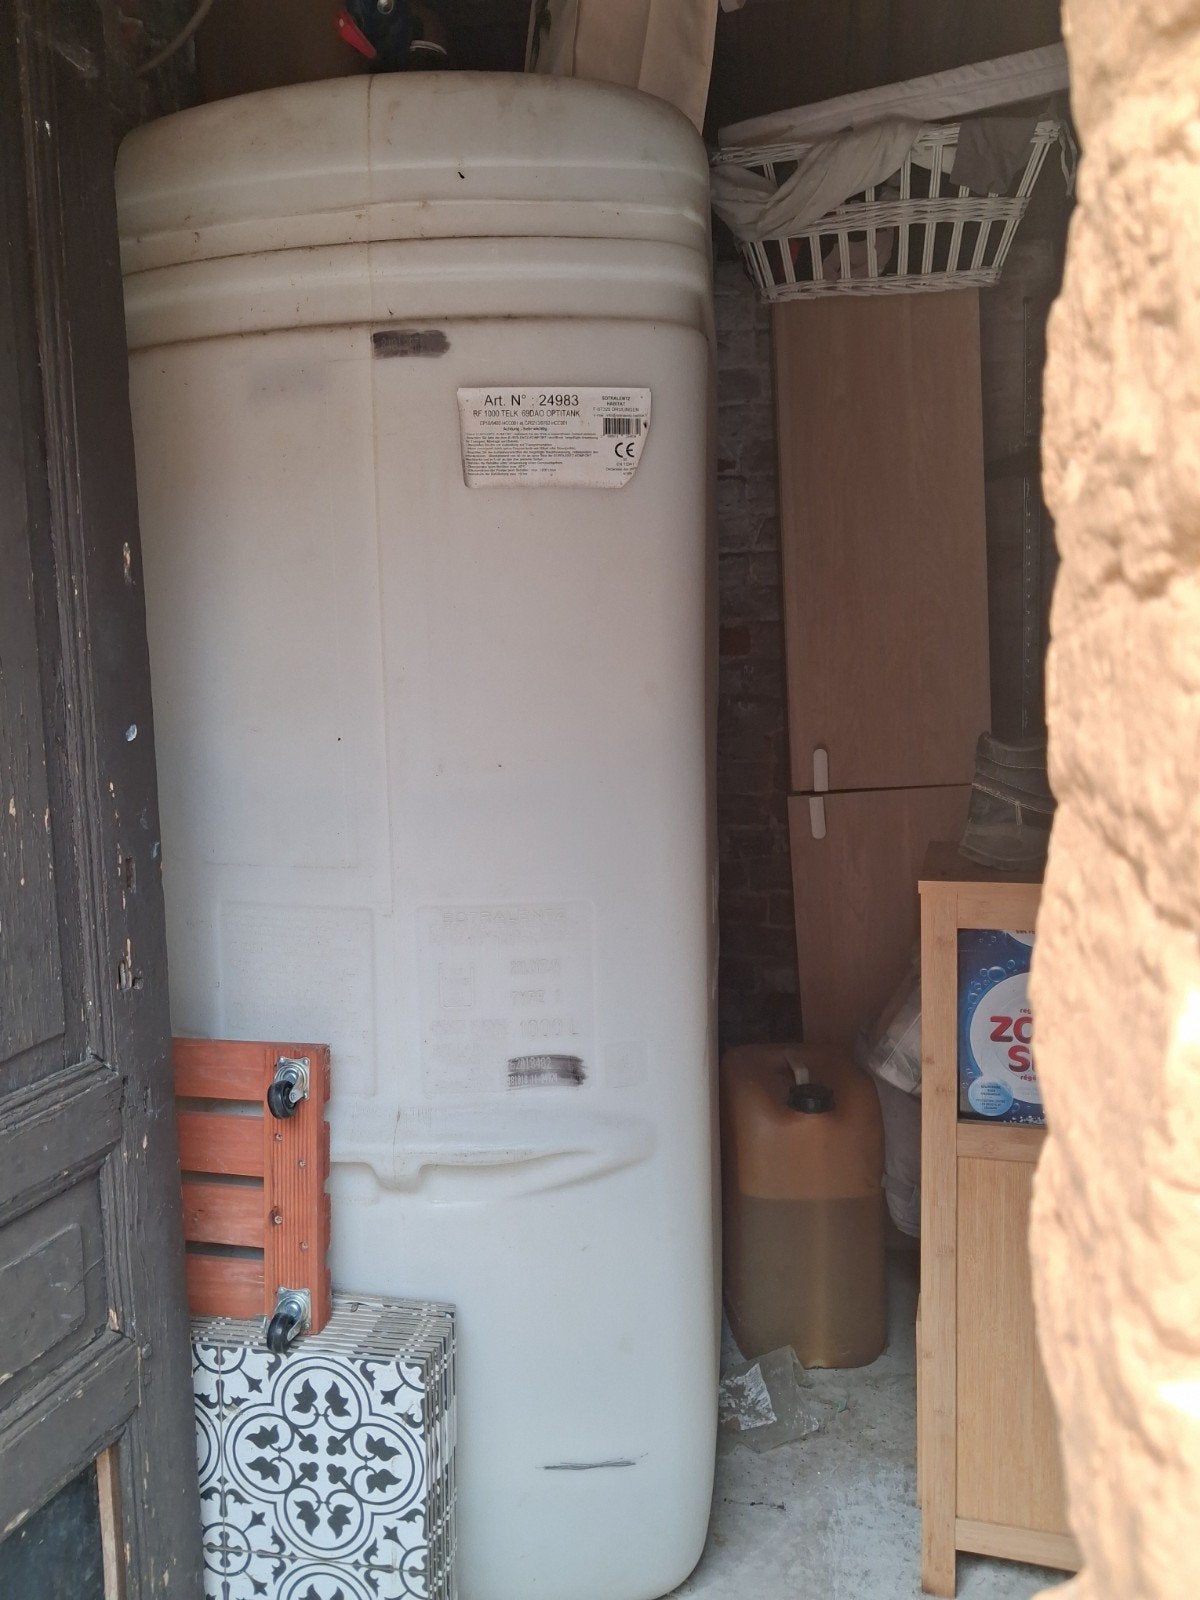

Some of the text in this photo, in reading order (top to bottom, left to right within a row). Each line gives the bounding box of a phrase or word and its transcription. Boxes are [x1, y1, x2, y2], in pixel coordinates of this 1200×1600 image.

[484, 394, 506, 407] Art.
[511, 394, 527, 406] N°
[538, 394, 580, 407] 24983
[472, 409, 482, 418] RF
[484, 409, 500, 418] 1000
[501, 409, 519, 418] TELK
[546, 409, 581, 418] OPTITANK
[614, 442, 635, 458] CE
[990, 1016, 1033, 1044] ZO
